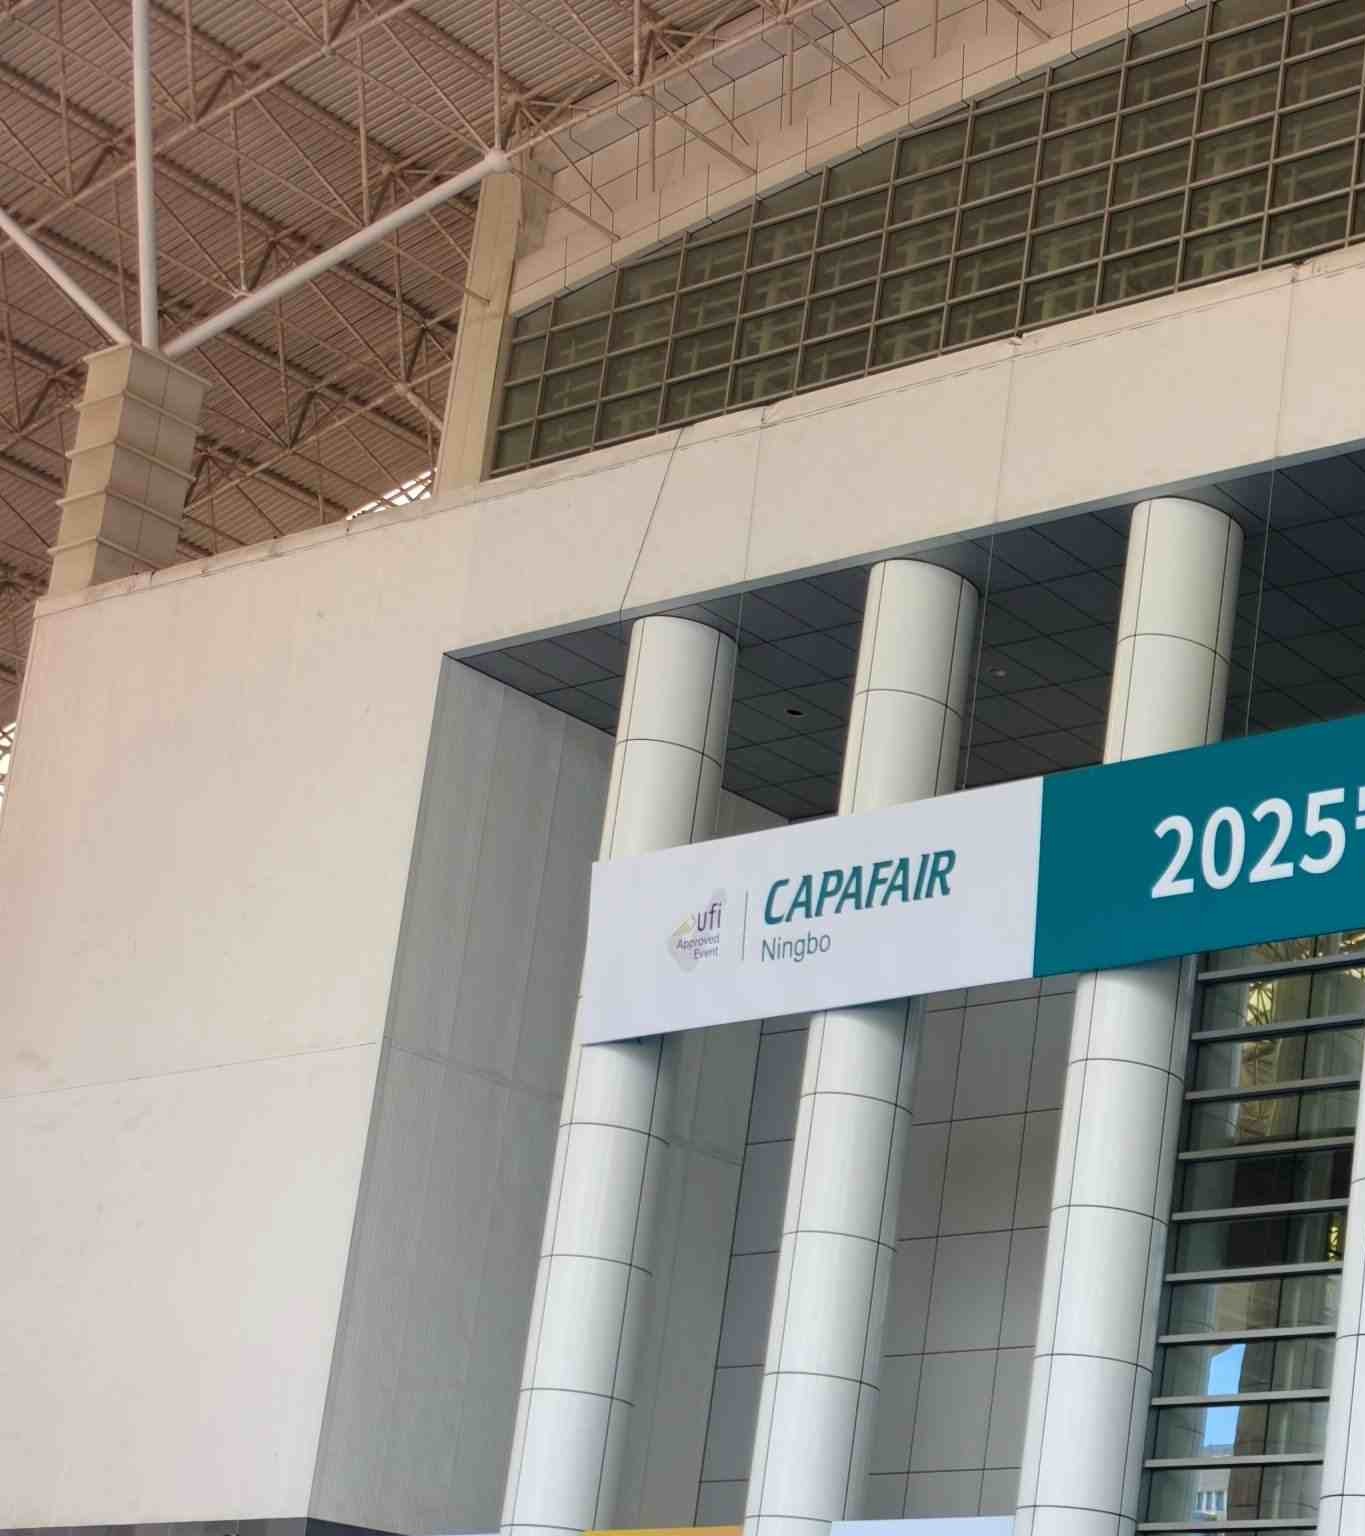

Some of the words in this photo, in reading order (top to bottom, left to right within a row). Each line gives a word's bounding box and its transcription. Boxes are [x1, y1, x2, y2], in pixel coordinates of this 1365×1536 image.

[763, 848, 957, 926] CAPAFAIR
[697, 901, 722, 932] ufi
[761, 931, 831, 963] Ningbo
